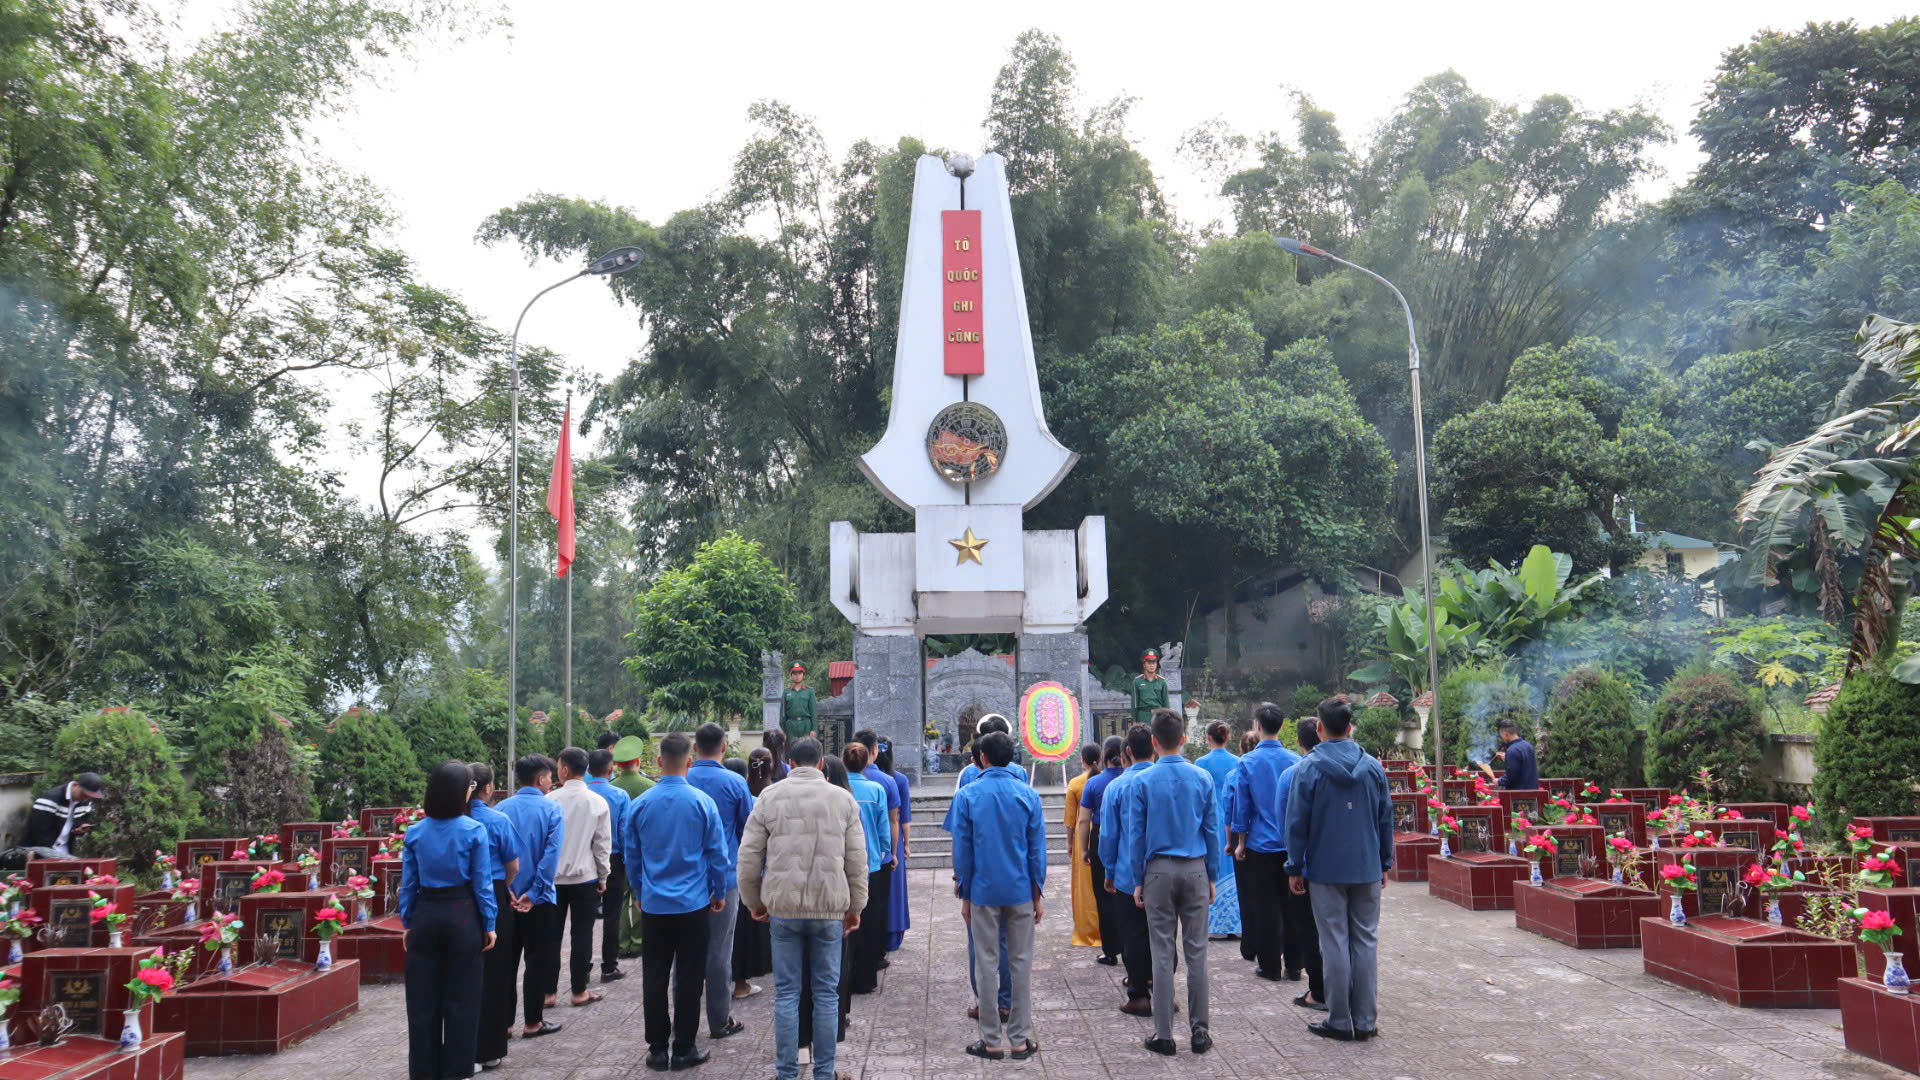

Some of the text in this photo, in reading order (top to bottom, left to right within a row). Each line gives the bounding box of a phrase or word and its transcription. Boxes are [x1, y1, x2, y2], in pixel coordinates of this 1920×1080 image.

[954, 234, 971, 251] TỔ
[947, 266, 979, 283] QUỐC
[953, 300, 974, 313] GHI
[947, 327, 980, 344] CÔNG
